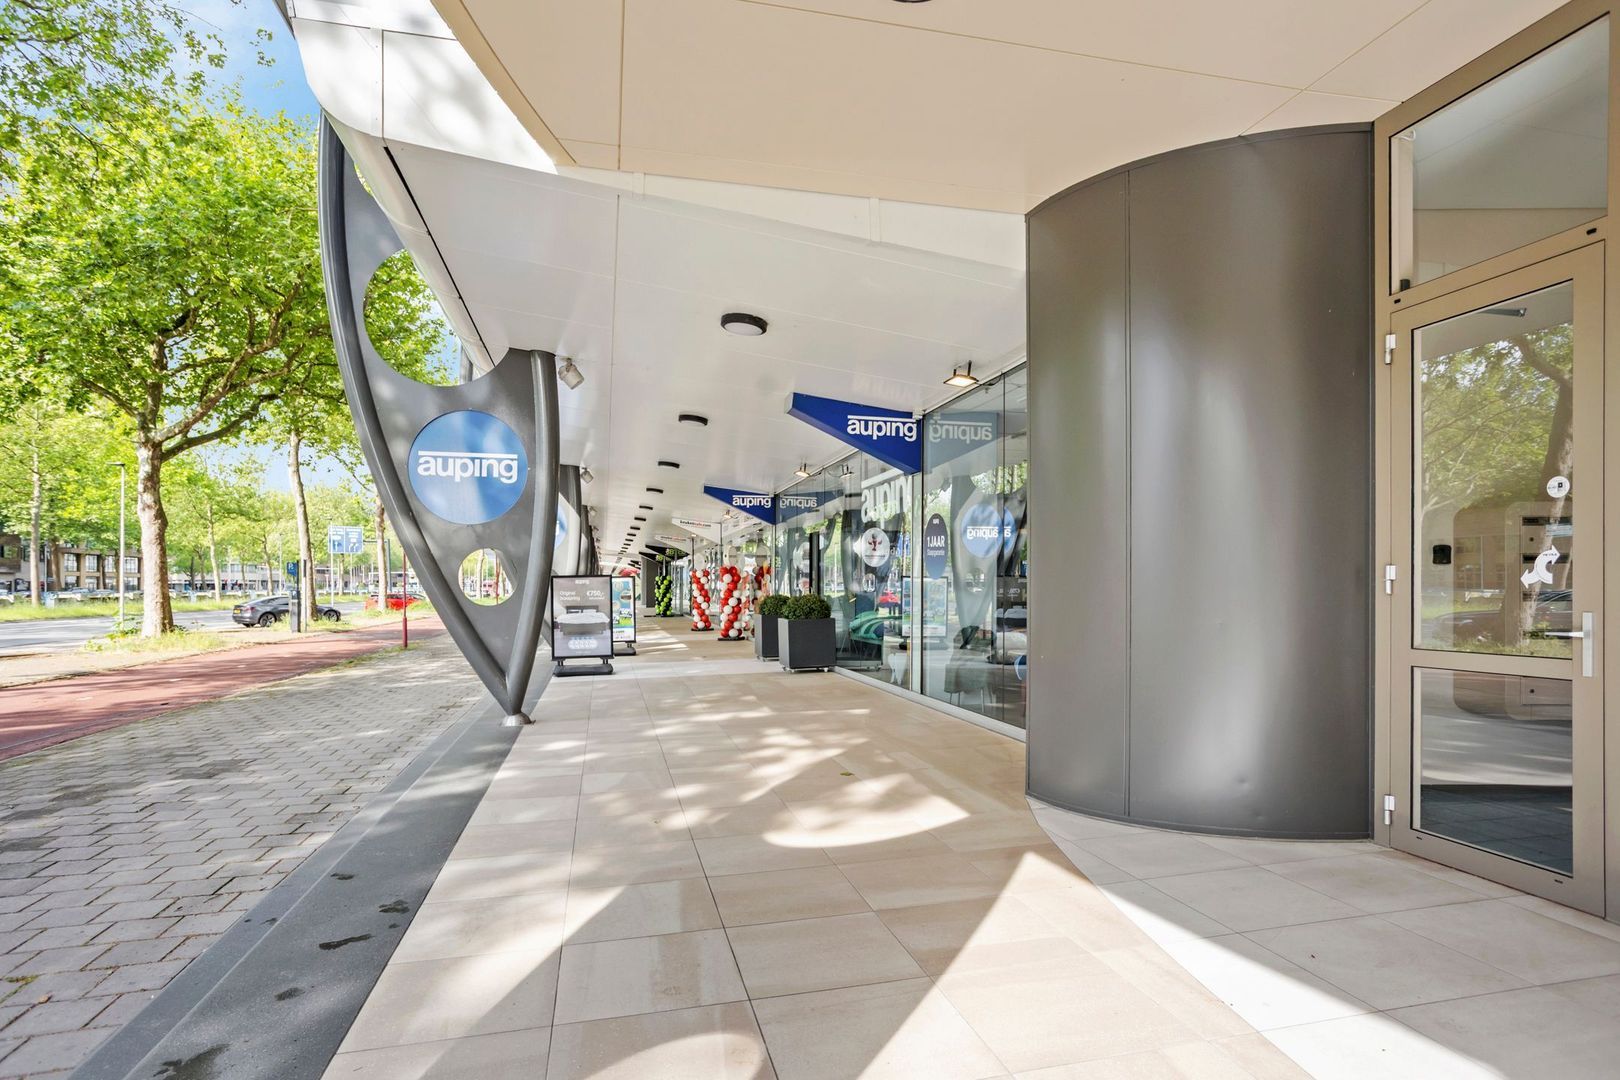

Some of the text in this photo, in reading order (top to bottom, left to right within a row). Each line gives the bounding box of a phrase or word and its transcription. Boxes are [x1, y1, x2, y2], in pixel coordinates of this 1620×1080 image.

[847, 415, 917, 442] auping
[417, 451, 518, 484] auping
[732, 495, 771, 508] auping
